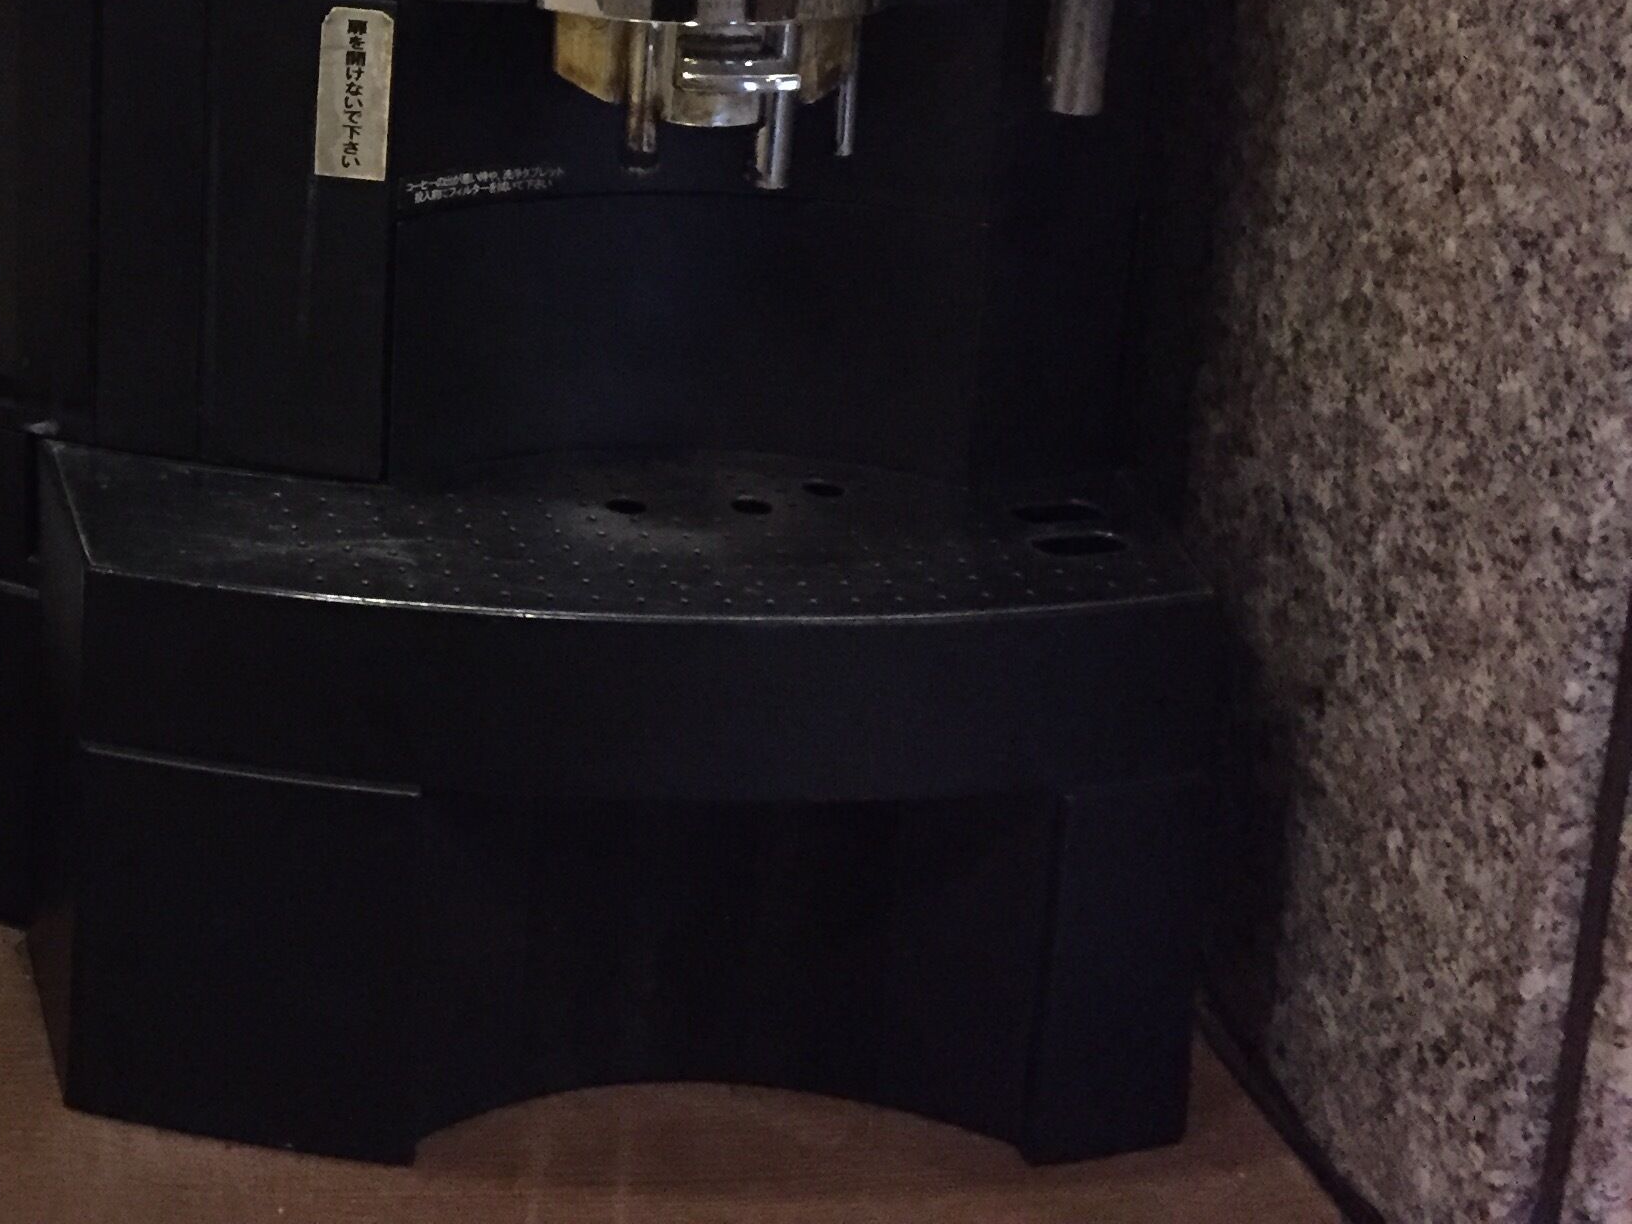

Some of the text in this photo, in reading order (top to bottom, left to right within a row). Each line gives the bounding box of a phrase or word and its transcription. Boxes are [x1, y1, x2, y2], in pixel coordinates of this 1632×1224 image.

[342, 19, 368, 168] 扉を開けないで下さい
